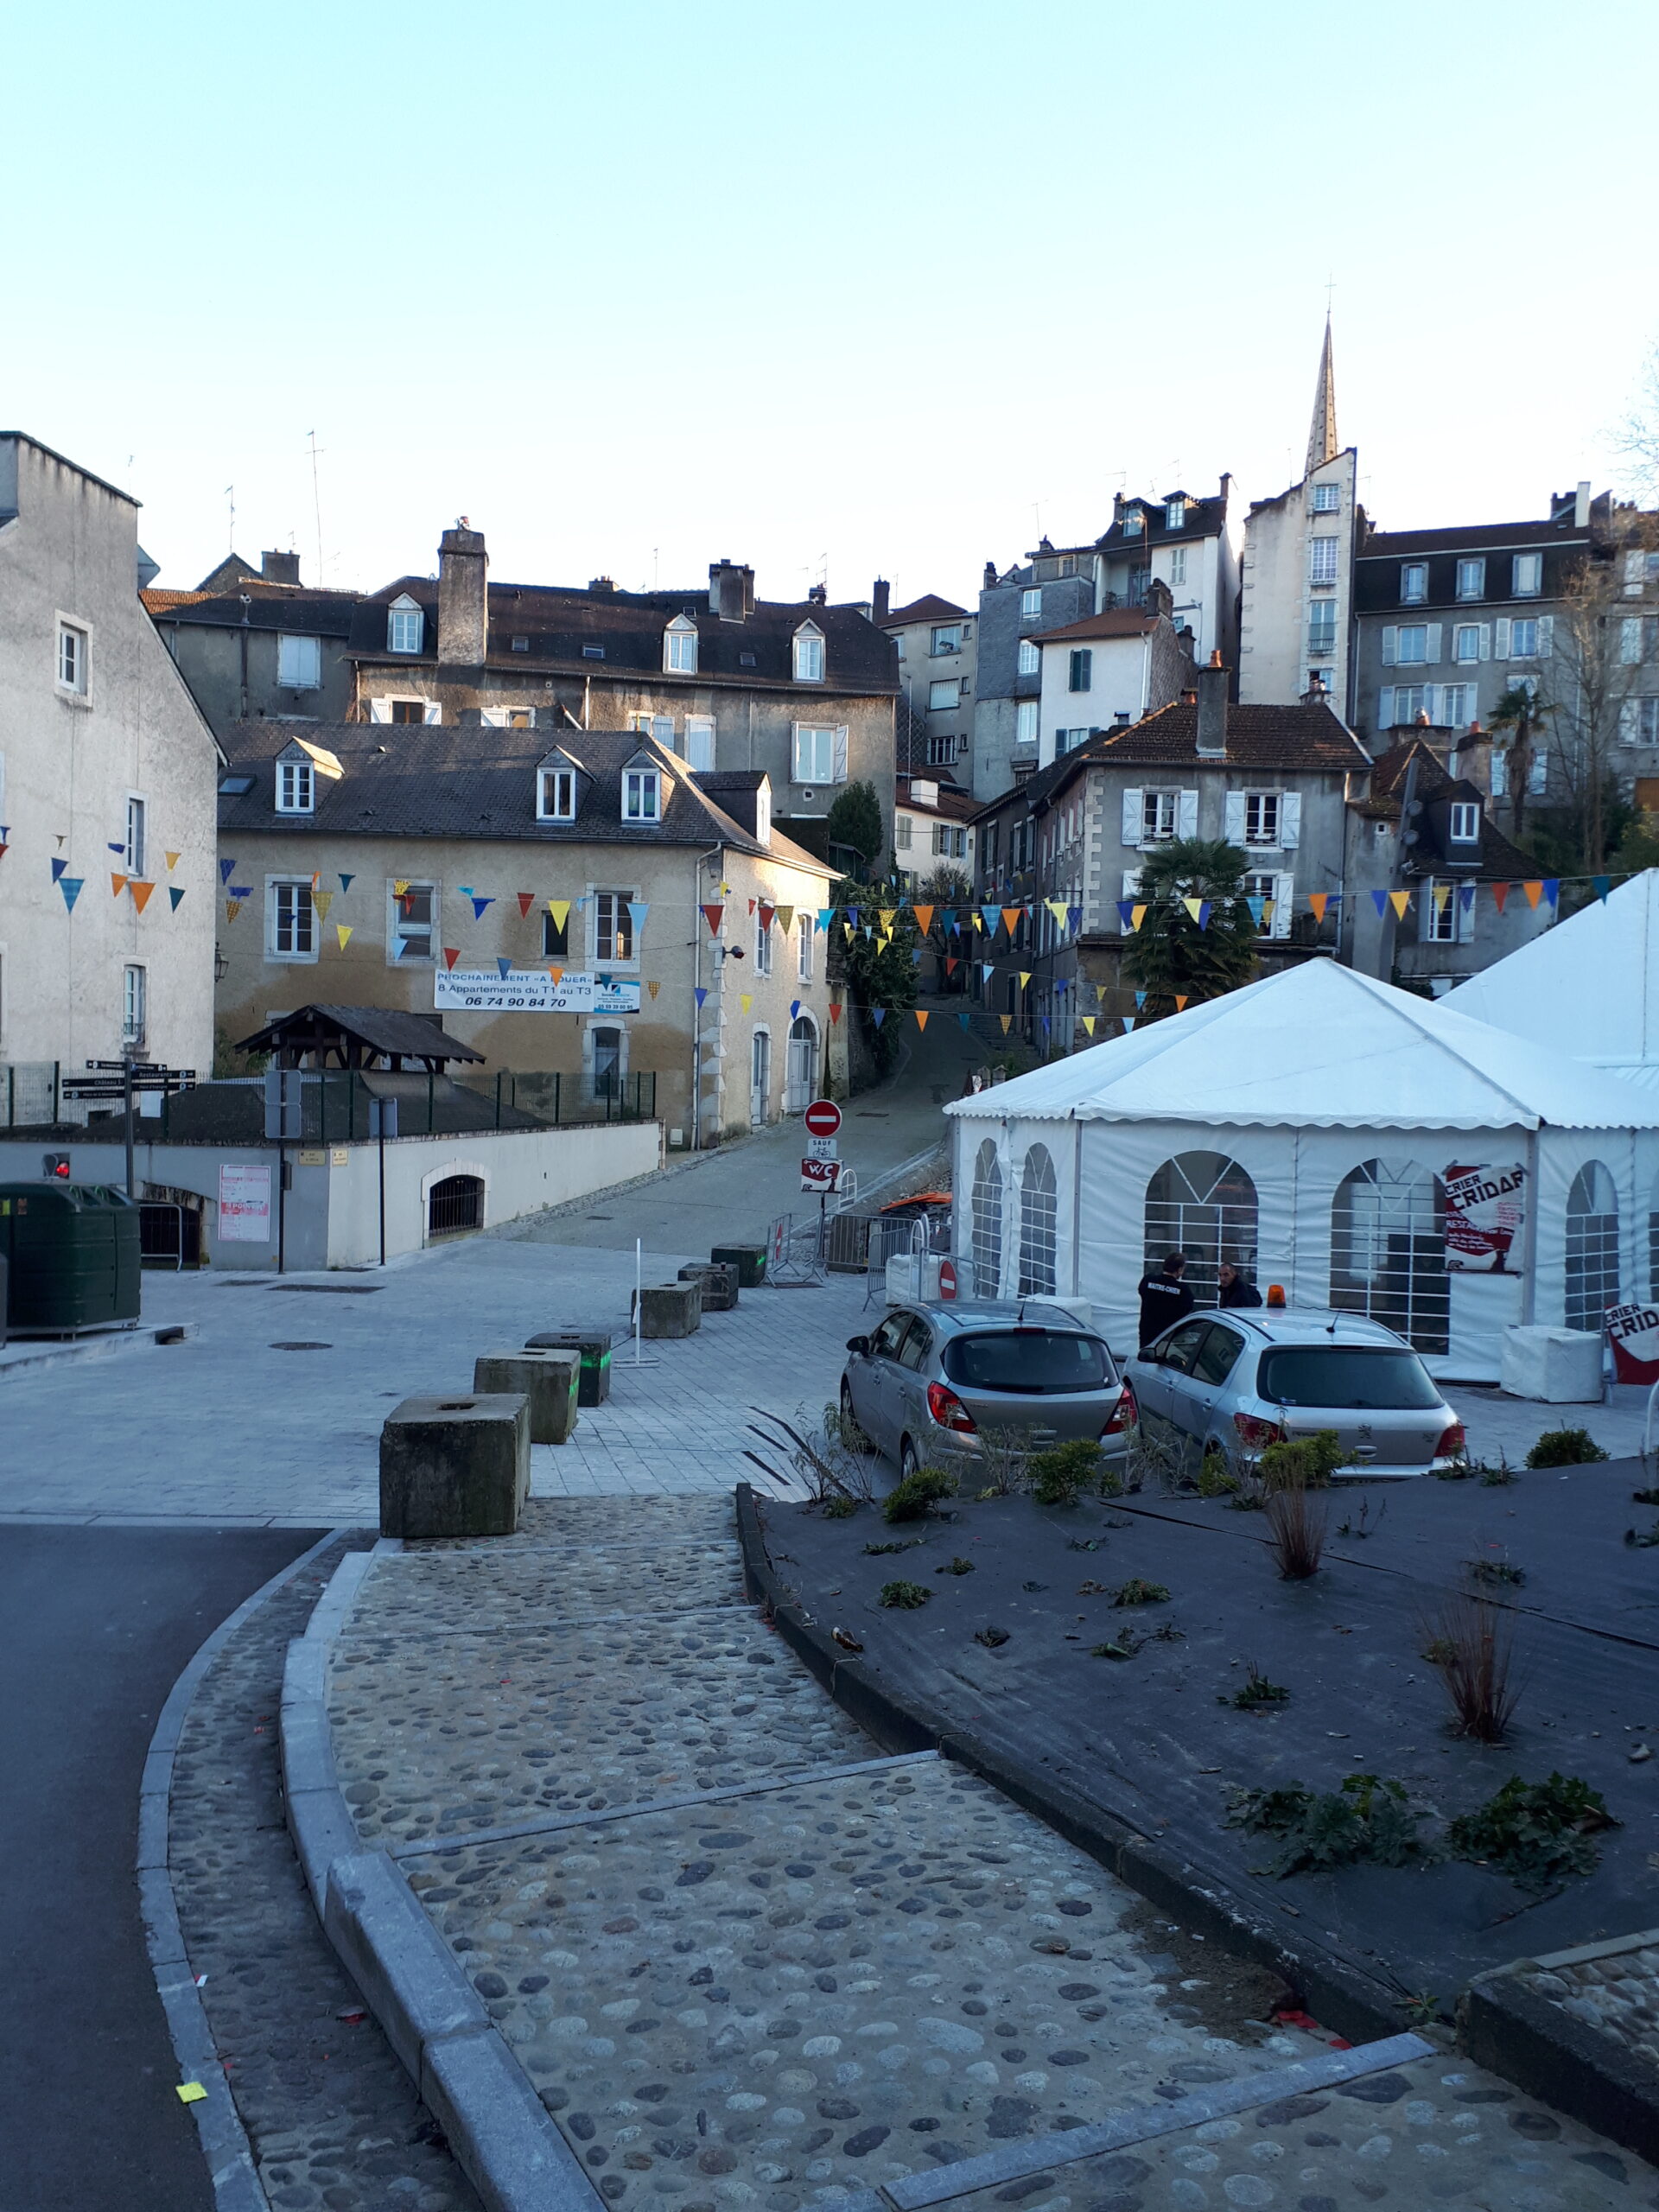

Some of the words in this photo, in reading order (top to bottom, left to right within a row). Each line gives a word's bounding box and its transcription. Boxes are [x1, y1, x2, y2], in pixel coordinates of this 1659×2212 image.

[449, 984, 522, 994] Appartements
[577, 986, 591, 995] T3
[465, 997, 482, 1006] 06
[487, 997, 503, 1006] 74
[507, 997, 524, 1007] 90
[529, 997, 545, 1007] 84
[550, 998, 566, 1007] 70
[809, 1165, 834, 1177] WC
[1445, 1174, 1481, 1195] CRIER
